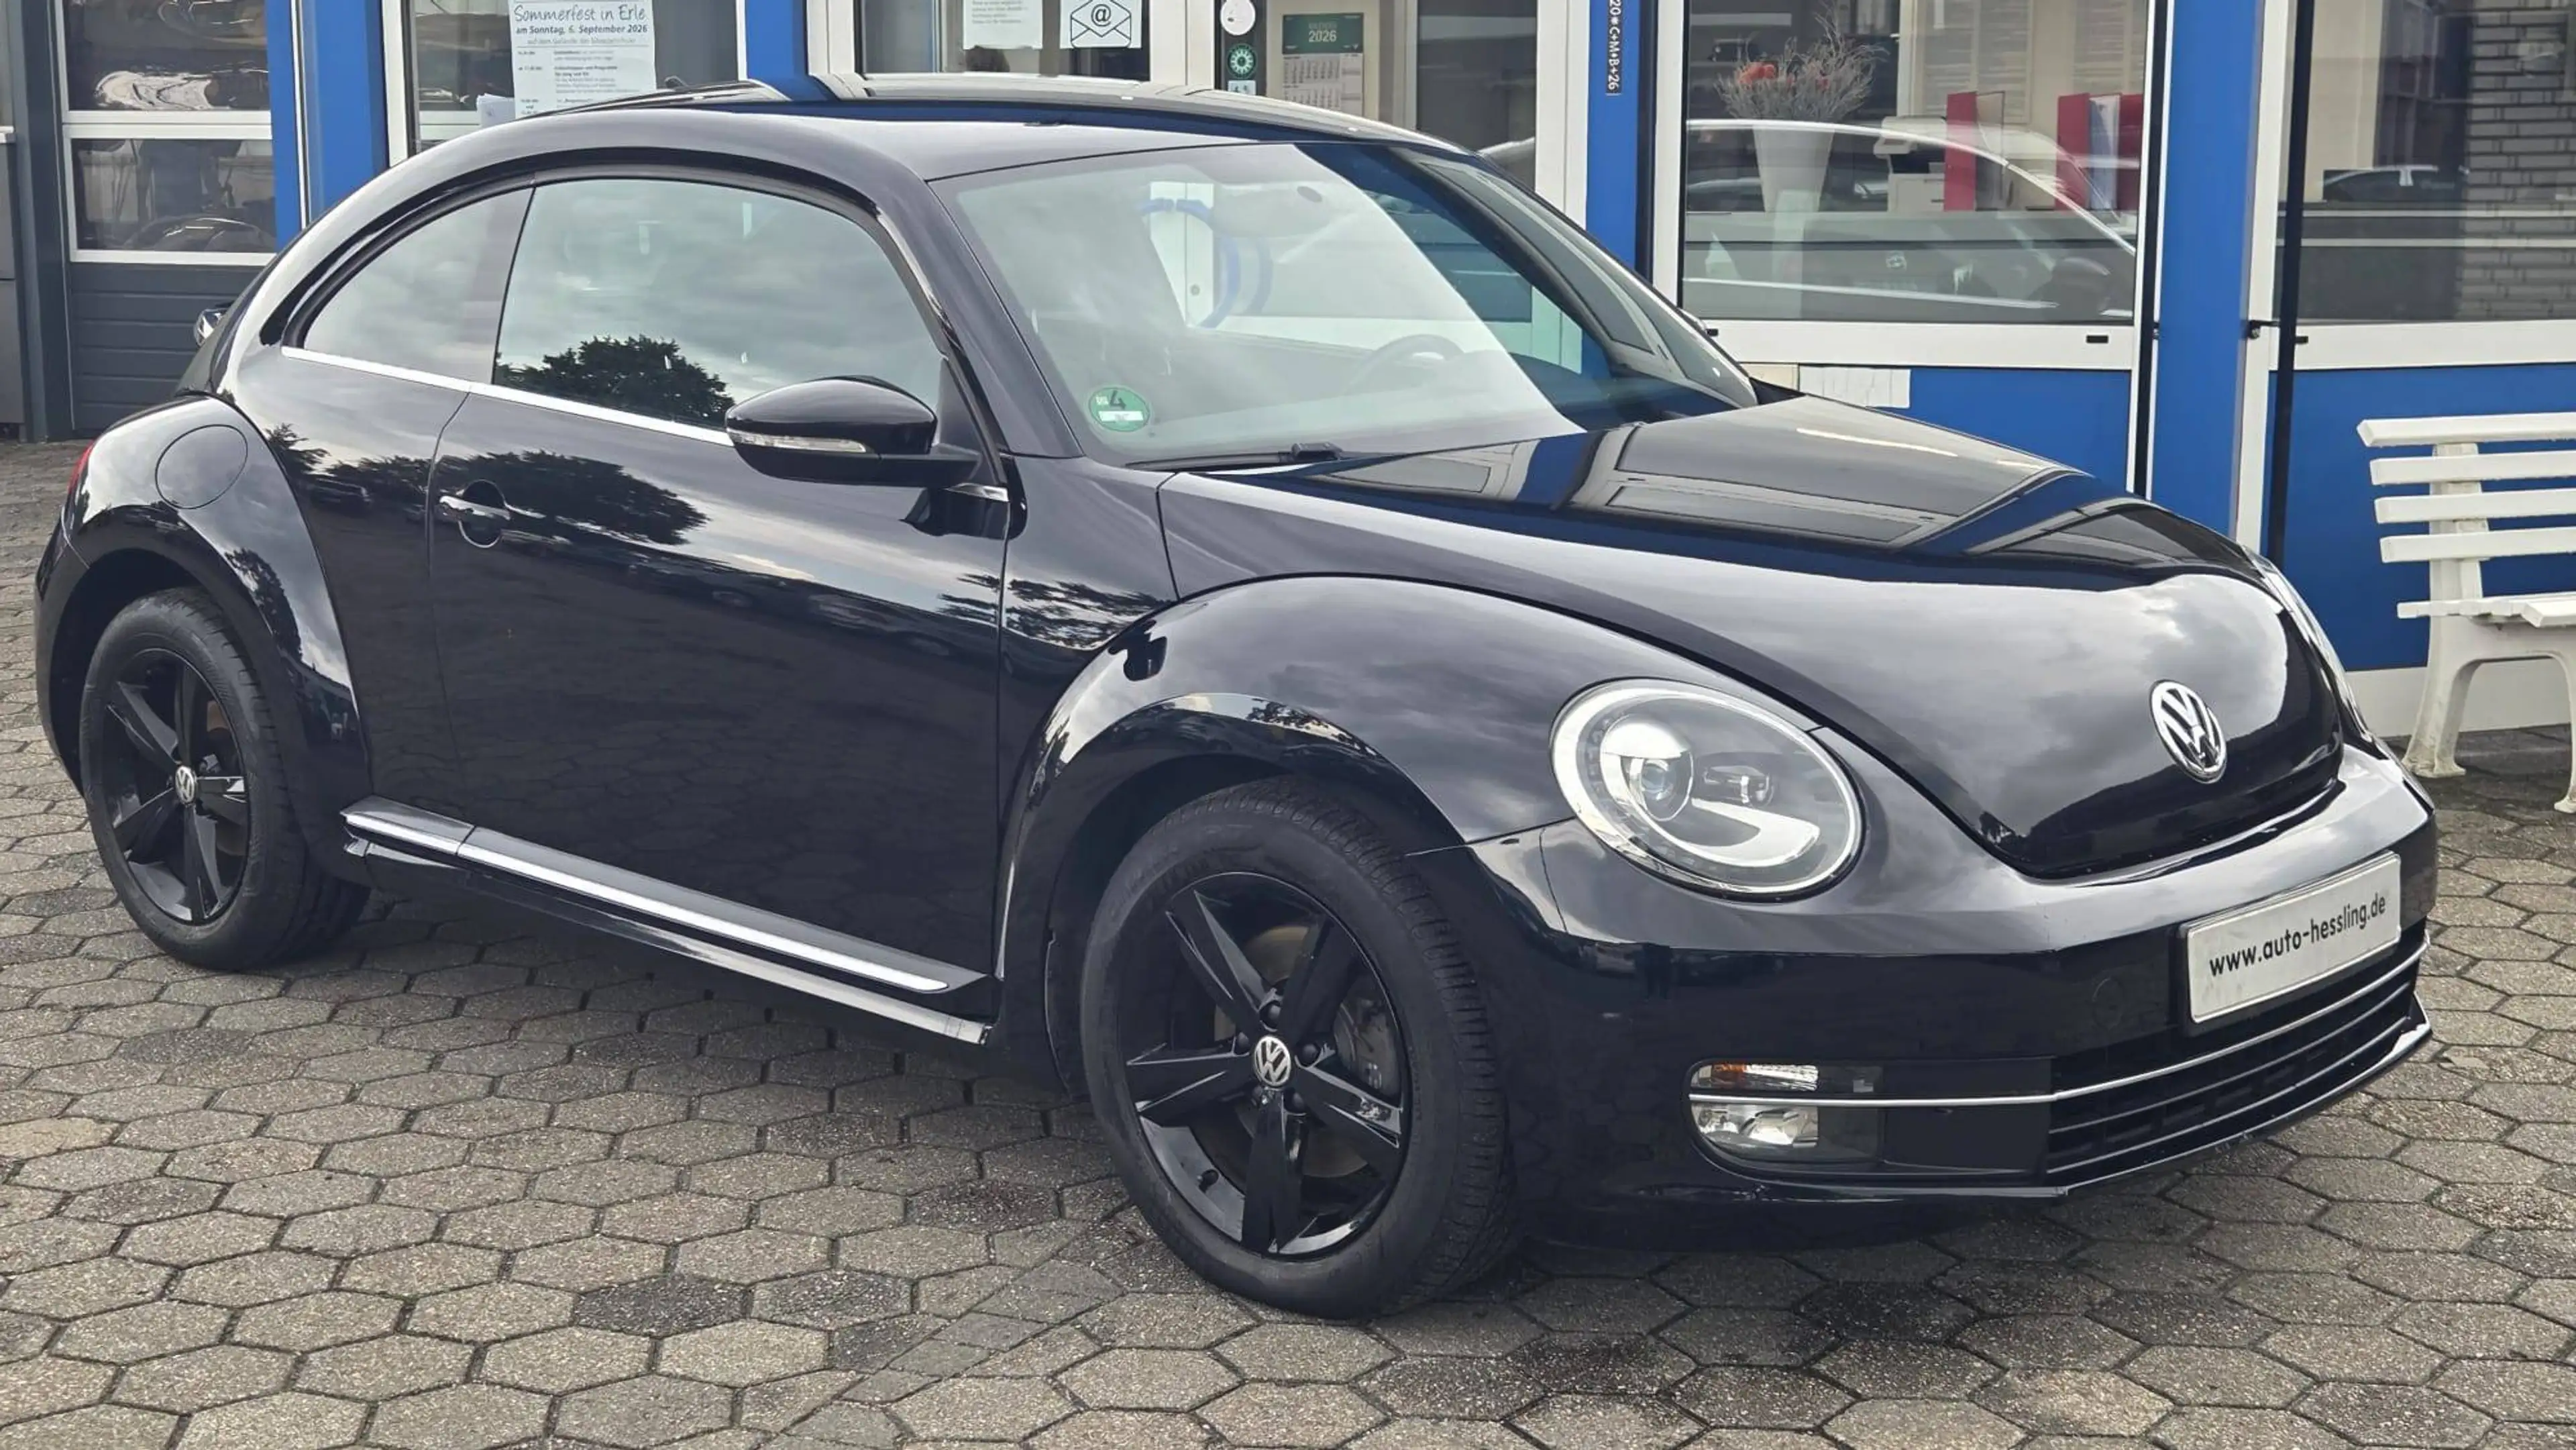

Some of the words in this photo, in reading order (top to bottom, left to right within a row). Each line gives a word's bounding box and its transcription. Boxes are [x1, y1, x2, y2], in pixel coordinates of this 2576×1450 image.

[514, 4, 596, 22] Sommerfest
[600, 9, 614, 21] in
[618, 3, 647, 21] Erle
[529, 25, 566, 36] Sonntag,
[578, 24, 625, 36] September
[627, 24, 648, 33] 2026
[1308, 30, 1337, 42] 2026
[1109, 390, 1127, 410] 4
[2150, 681, 2225, 781] VW
[2209, 892, 2386, 977] www.auto-hessling.de
[1254, 1035, 1291, 1086] VW
